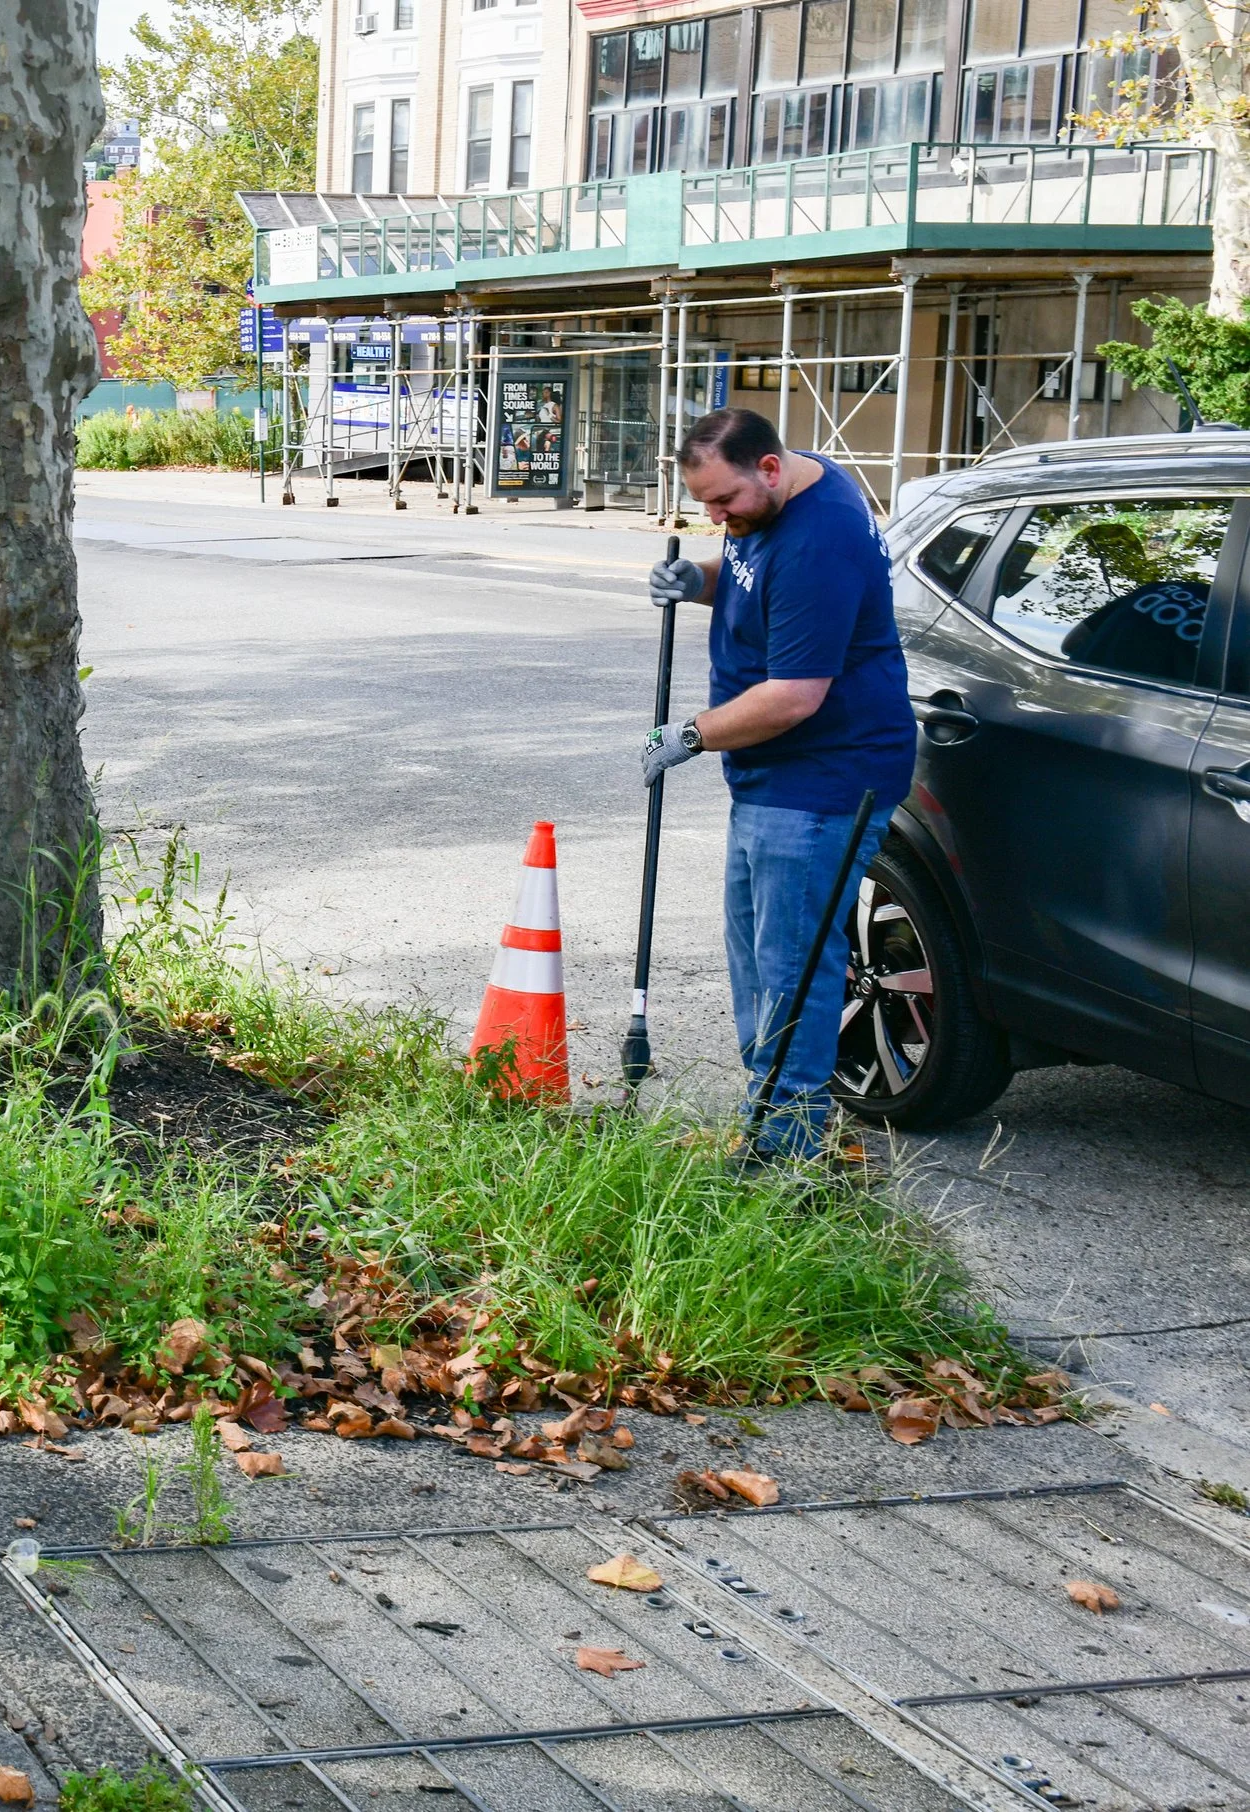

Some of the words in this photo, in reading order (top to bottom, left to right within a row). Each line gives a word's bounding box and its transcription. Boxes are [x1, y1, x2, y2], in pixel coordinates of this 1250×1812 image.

[356, 346, 384, 357] HEALTH
[503, 383, 527, 391] FROM
[503, 392, 527, 400] TIMES
[714, 381, 724, 406] Street
[503, 401, 535, 410] SQUARE
[533, 453, 543, 461] TO
[544, 453, 560, 461] THE
[530, 462, 559, 470] WORLD
